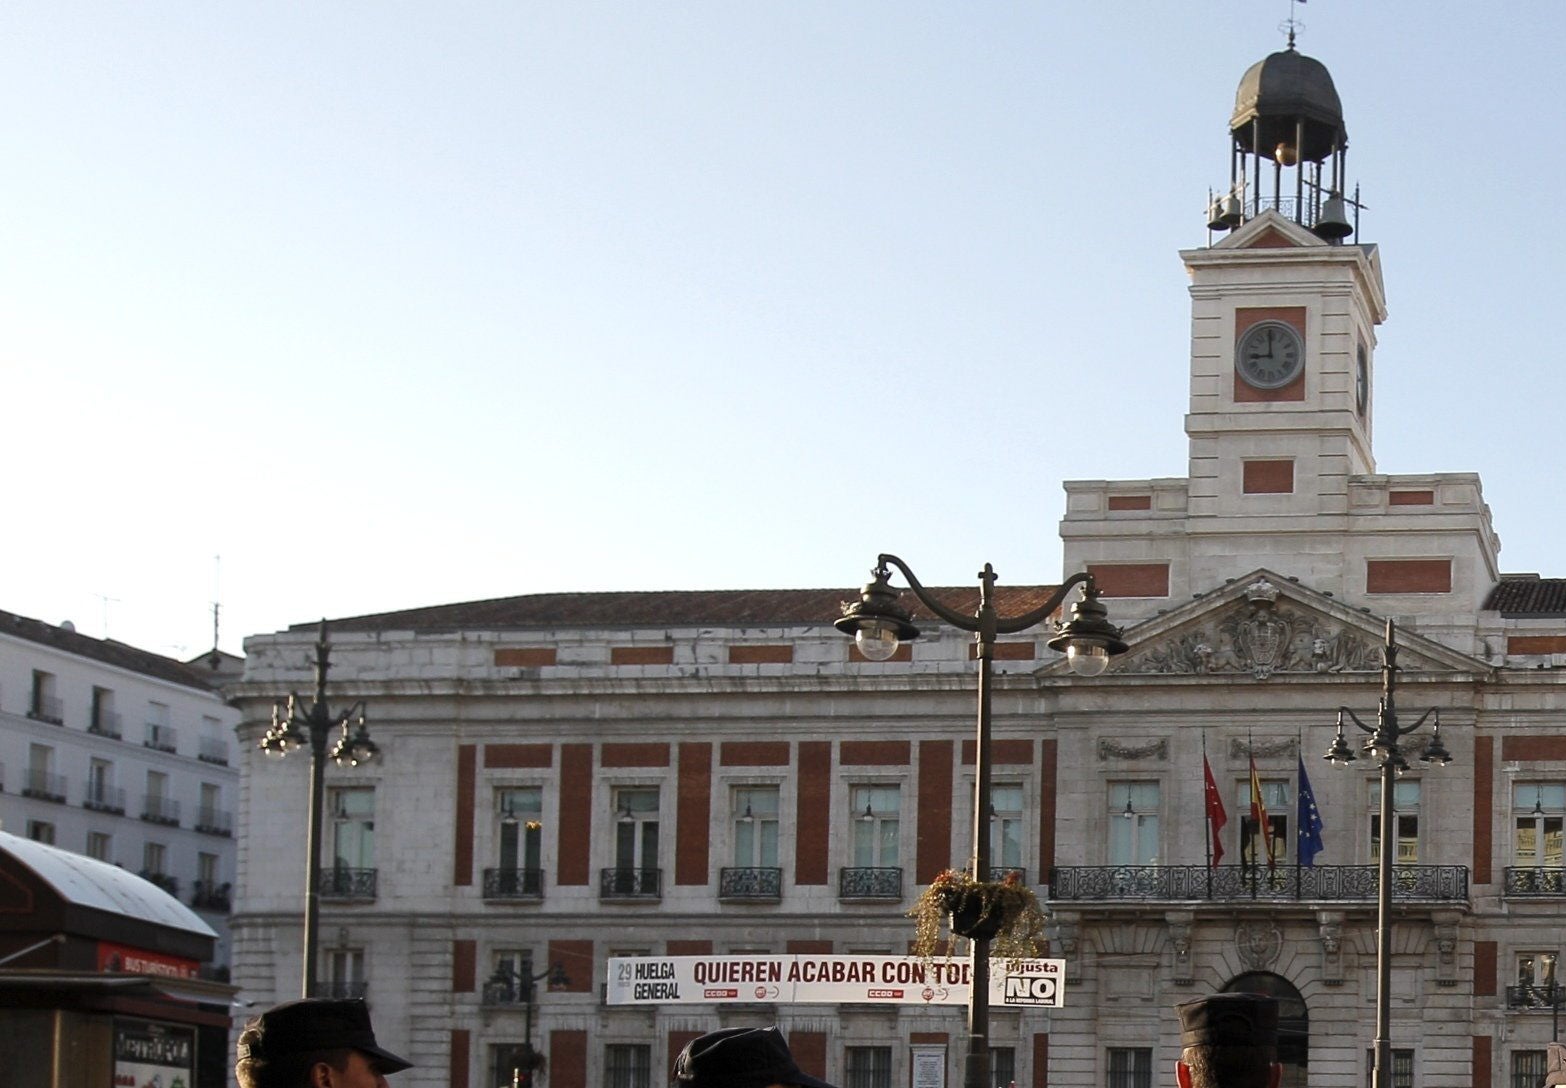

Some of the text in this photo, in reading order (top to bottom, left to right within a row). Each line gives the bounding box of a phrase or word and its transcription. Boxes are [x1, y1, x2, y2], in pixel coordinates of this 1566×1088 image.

[618, 963, 632, 980] 29
[635, 962, 675, 980] HUELGA
[694, 961, 970, 985] QUIEREN ACABAR CON TOD
[634, 982, 680, 1000] GENERAL
[1006, 978, 1055, 998] NO
